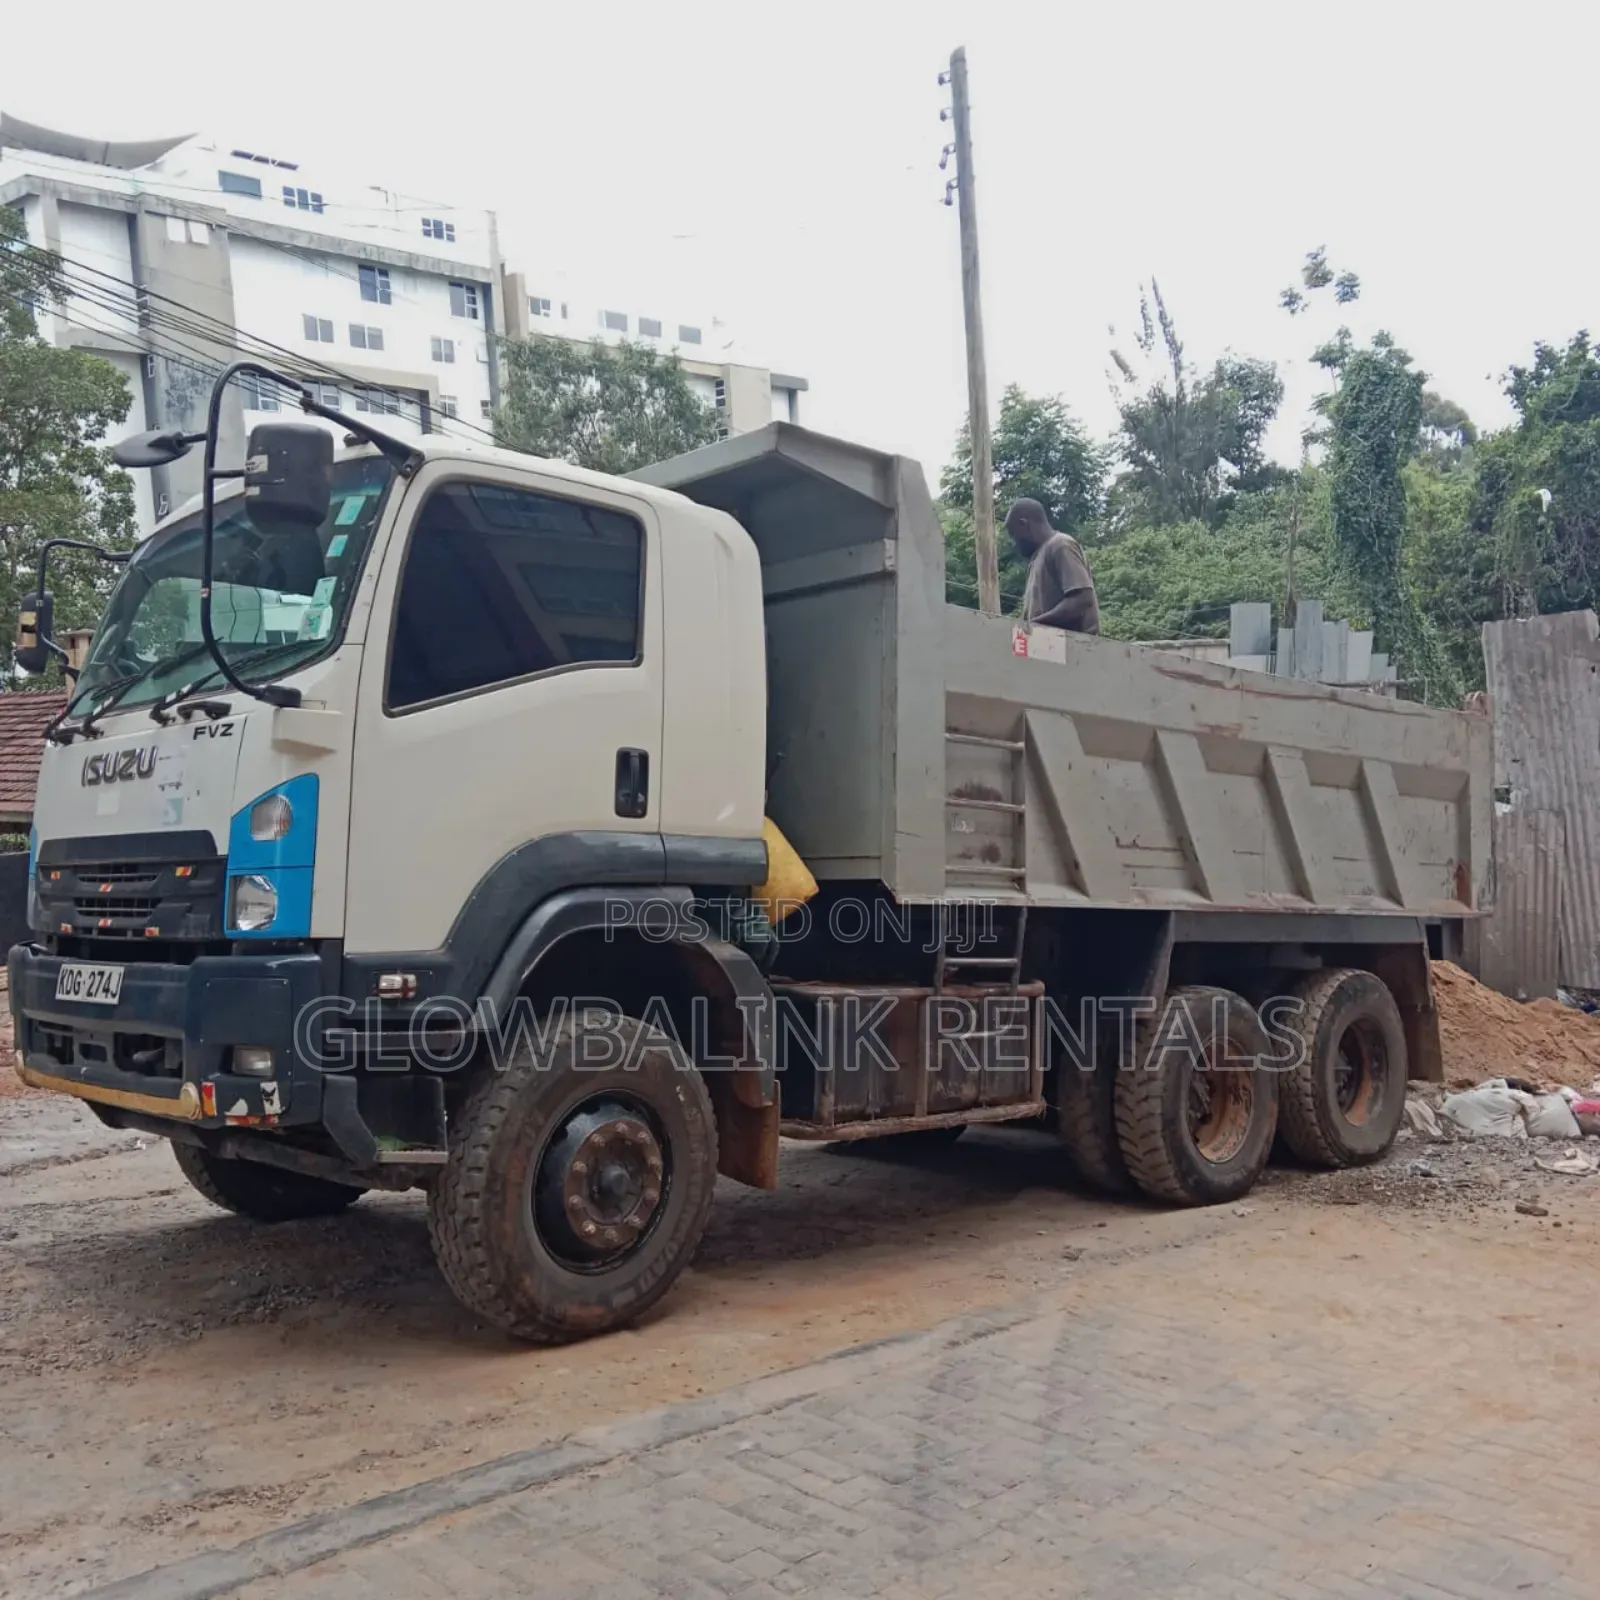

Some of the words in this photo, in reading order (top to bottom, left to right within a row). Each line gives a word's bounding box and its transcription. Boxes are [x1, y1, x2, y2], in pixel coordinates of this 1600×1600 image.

[193, 723, 234, 741] FVZ
[81, 745, 159, 787] ISUZU
[59, 968, 82, 996] KDG
[86, 969, 122, 999] 274J
